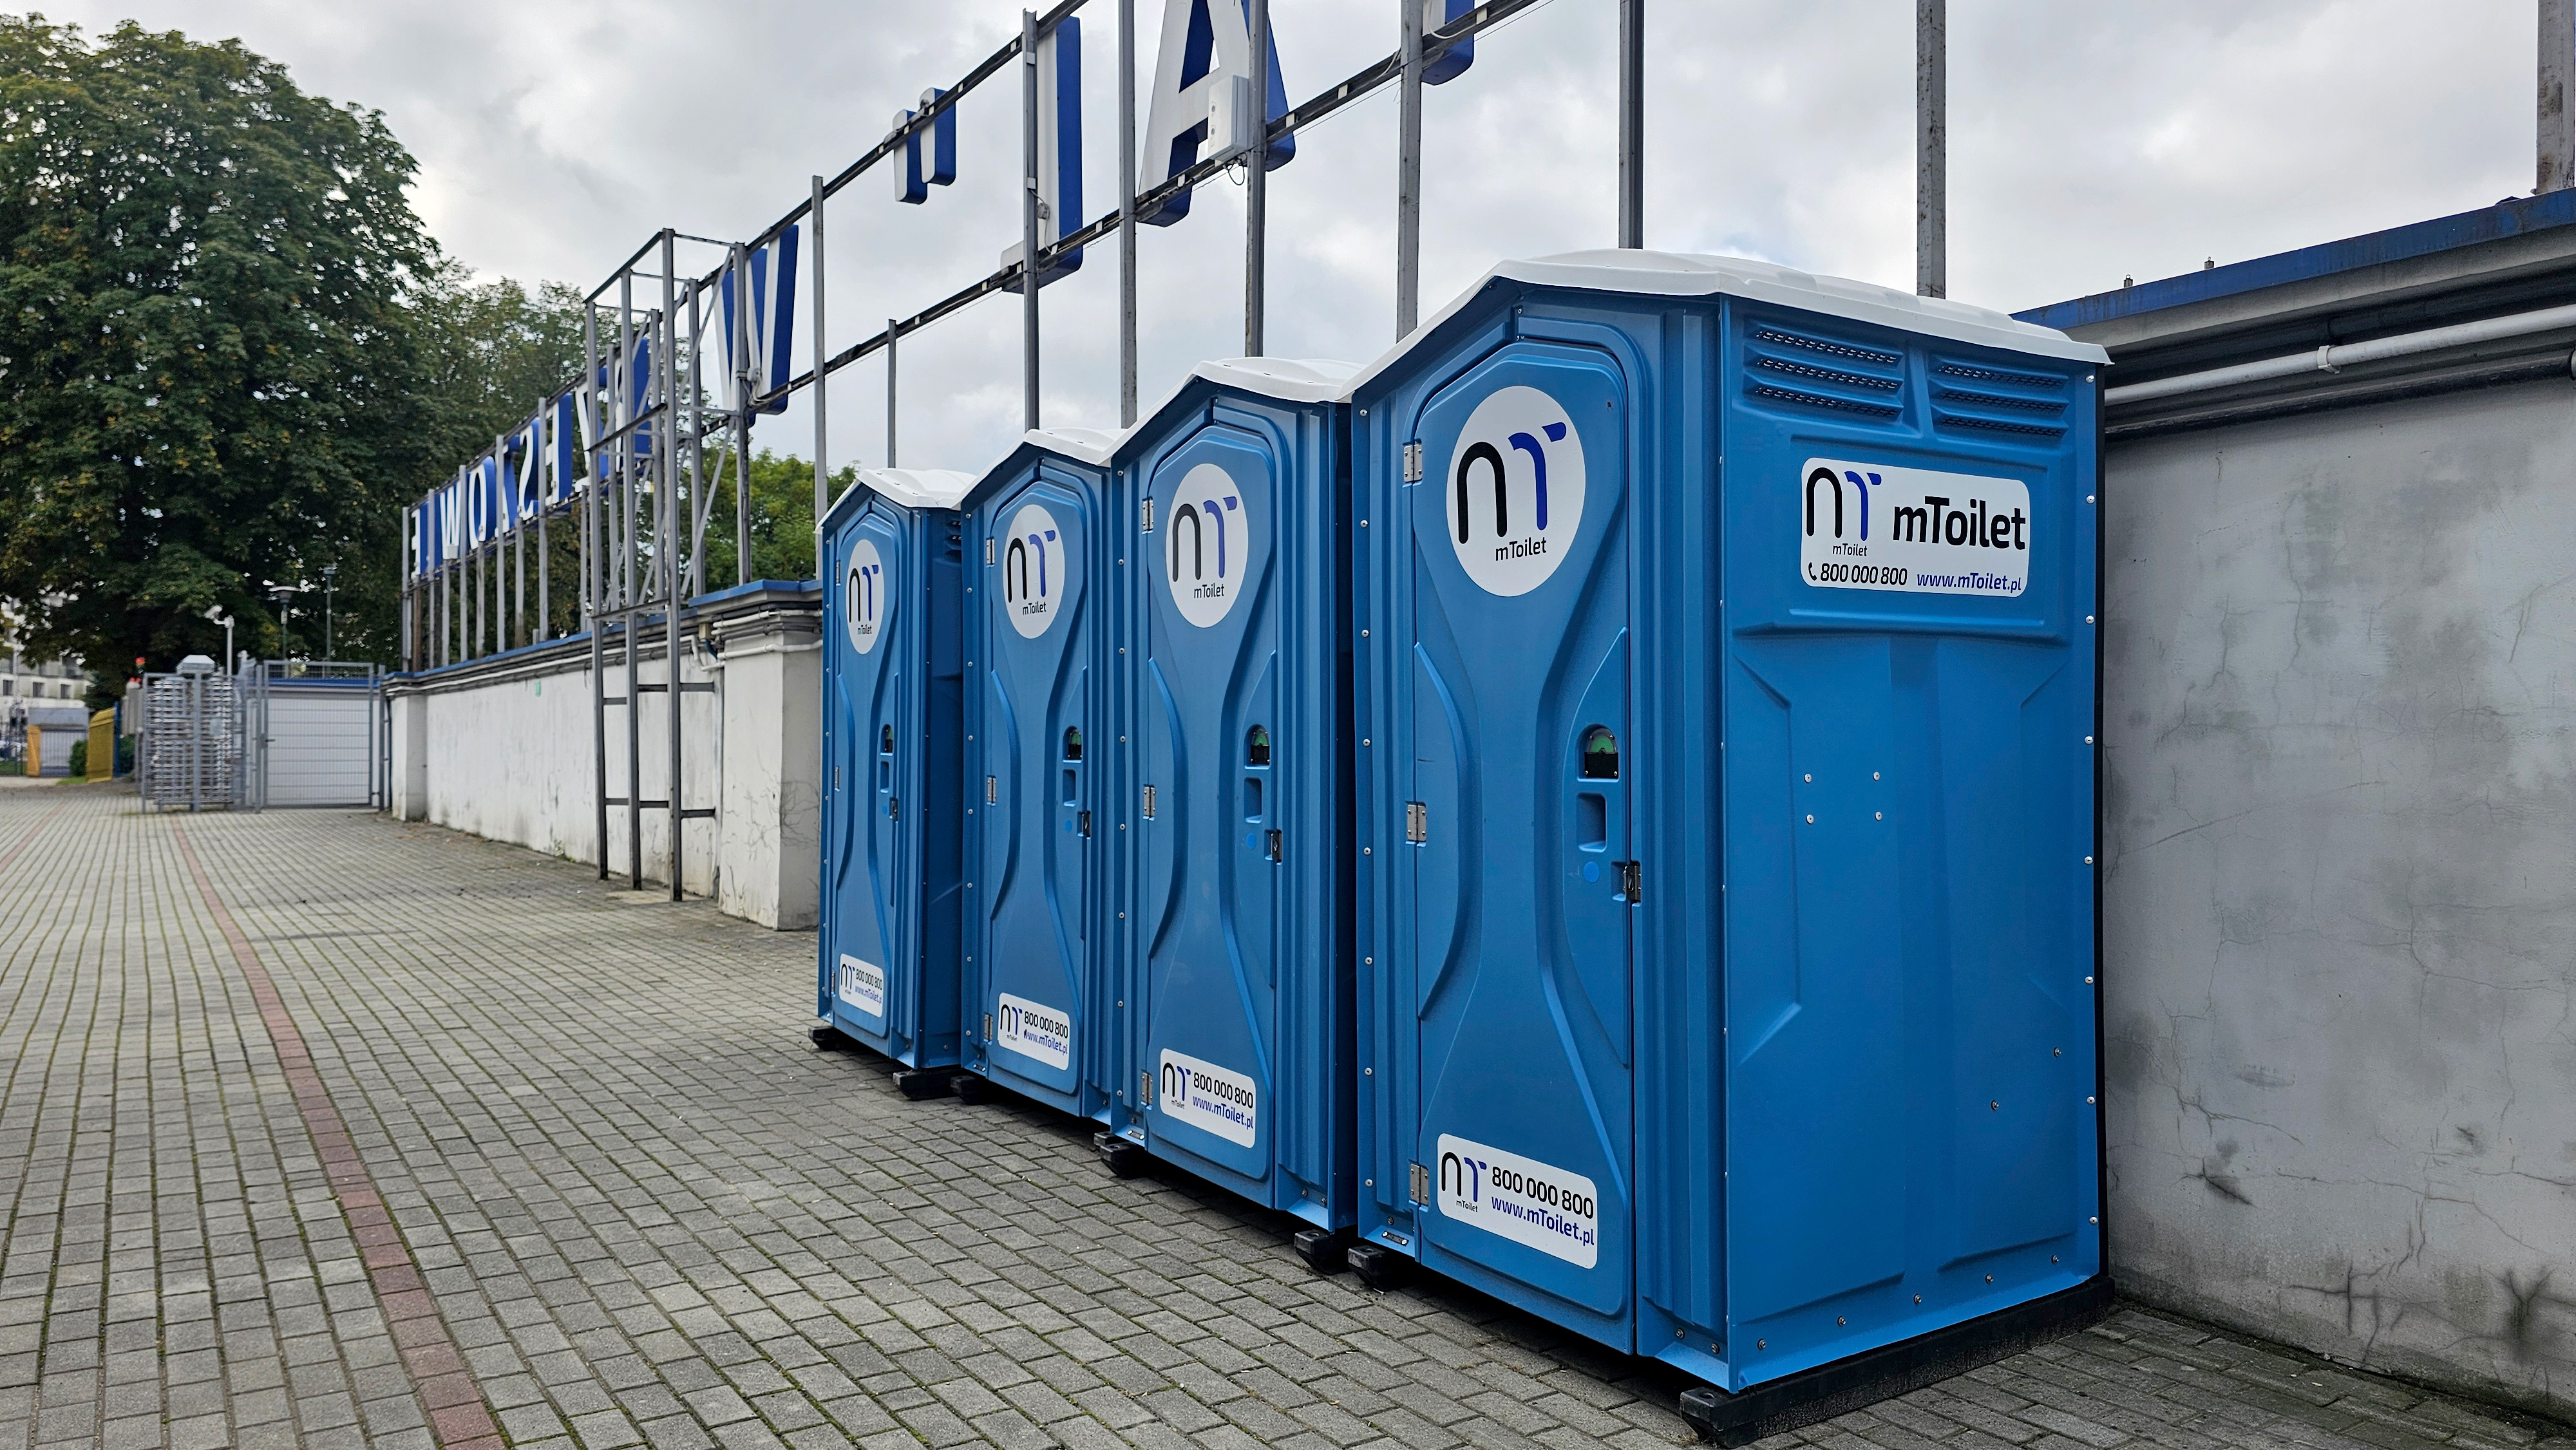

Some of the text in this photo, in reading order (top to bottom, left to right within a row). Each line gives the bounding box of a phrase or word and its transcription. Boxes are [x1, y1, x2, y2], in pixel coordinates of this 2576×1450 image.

[1893, 496, 2026, 551] mToilet
[1495, 537, 1547, 561] mToilet
[1832, 543, 1868, 557] mToilet
[1820, 563, 1908, 586] 800 000 800
[1916, 572, 2022, 594] www.mToilet.pl
[1193, 582, 1225, 599] mToilet
[1023, 601, 1046, 616] mToilet
[1025, 1011, 1068, 1039] 800 000 800
[1193, 1072, 1253, 1109] 800 000 800
[1193, 1095, 1254, 1130] www.mToilet.pl
[1492, 1166, 1594, 1219] 800 000 800
[1456, 1200, 1478, 1213] mToilet
[1491, 1196, 1595, 1246] www.mToilet.pl
